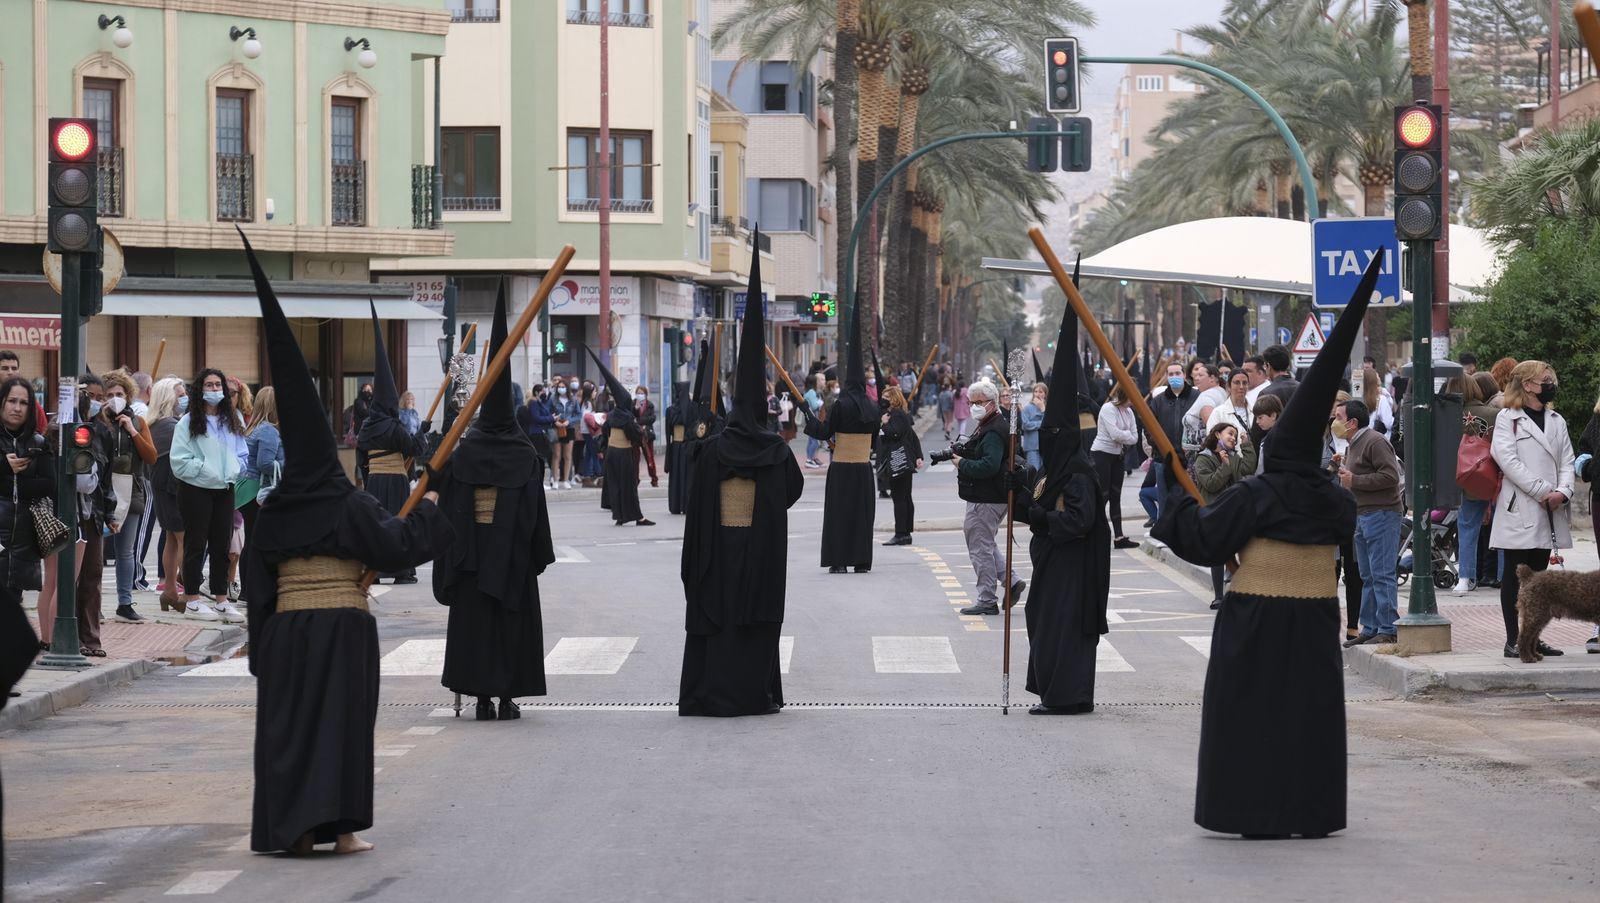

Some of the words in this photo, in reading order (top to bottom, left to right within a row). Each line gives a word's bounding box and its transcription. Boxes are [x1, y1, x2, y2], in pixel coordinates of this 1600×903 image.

[1321, 249, 1393, 276] TAXI
[416, 282, 427, 291] 51
[430, 282, 443, 291] 65
[416, 293, 429, 302] 29
[430, 293, 443, 302] 40
